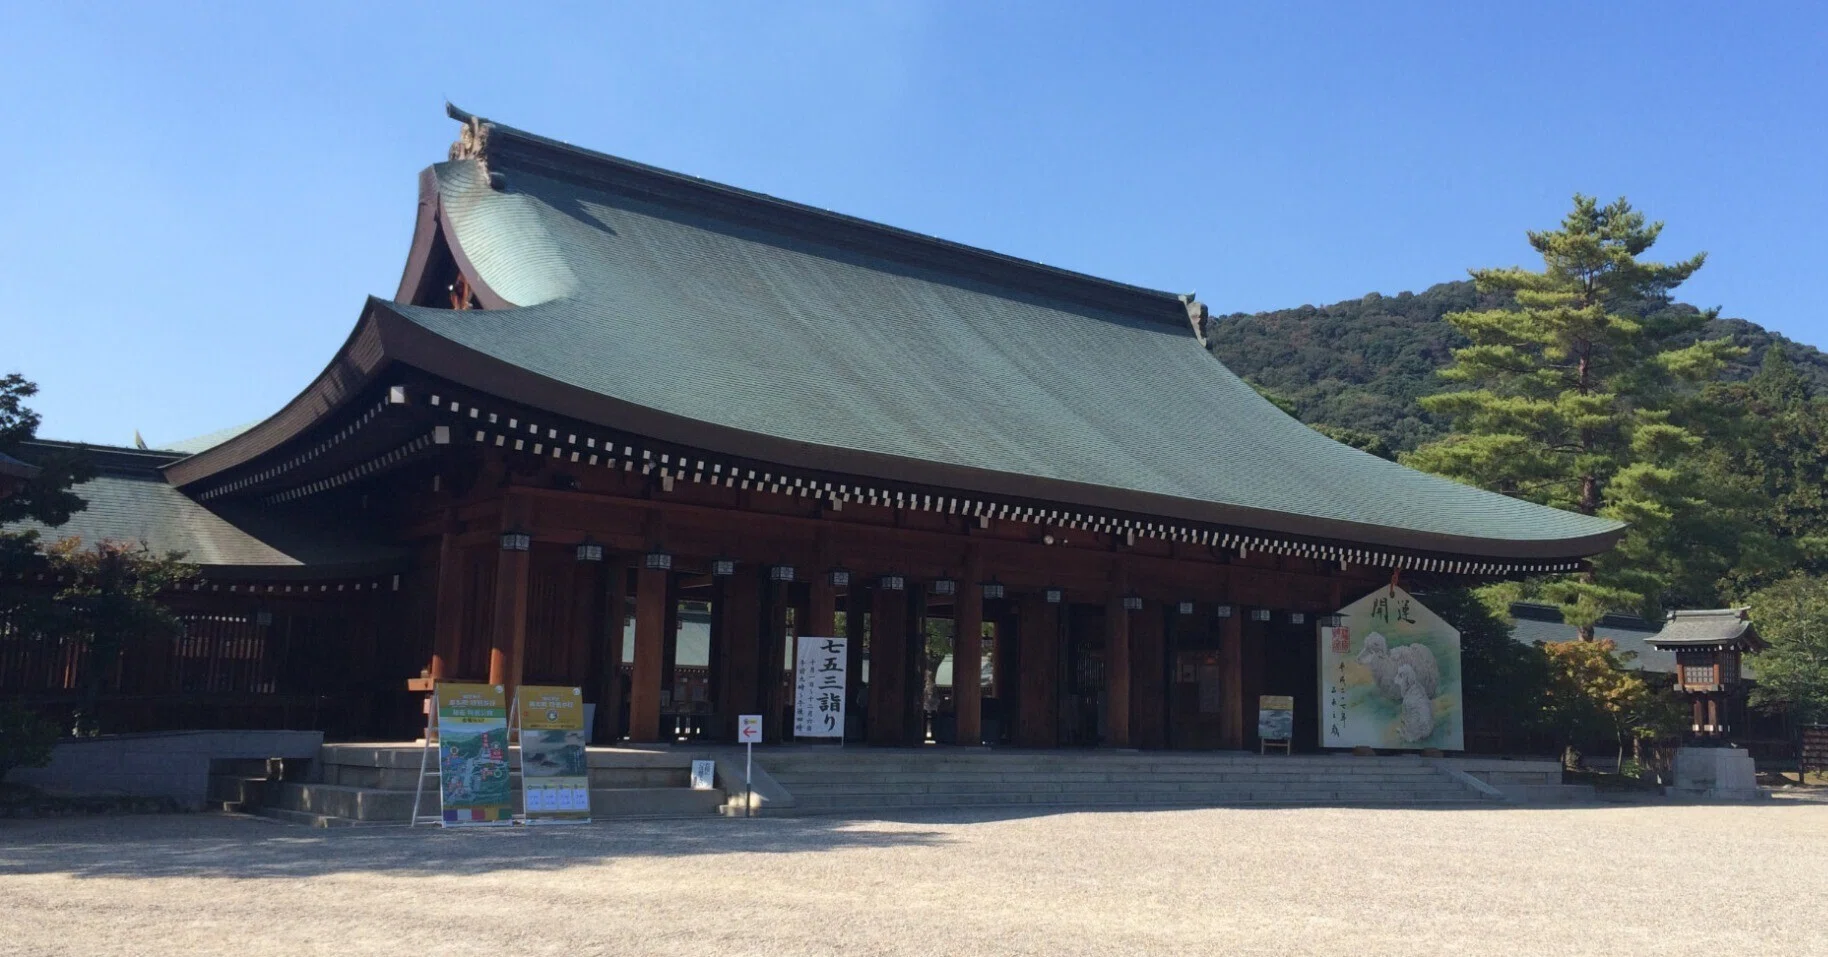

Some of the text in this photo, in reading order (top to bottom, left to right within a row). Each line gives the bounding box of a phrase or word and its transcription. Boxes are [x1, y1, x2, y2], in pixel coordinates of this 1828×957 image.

[1371, 597, 1416, 624] 開運
[816, 639, 845, 732] 七五三詣り
